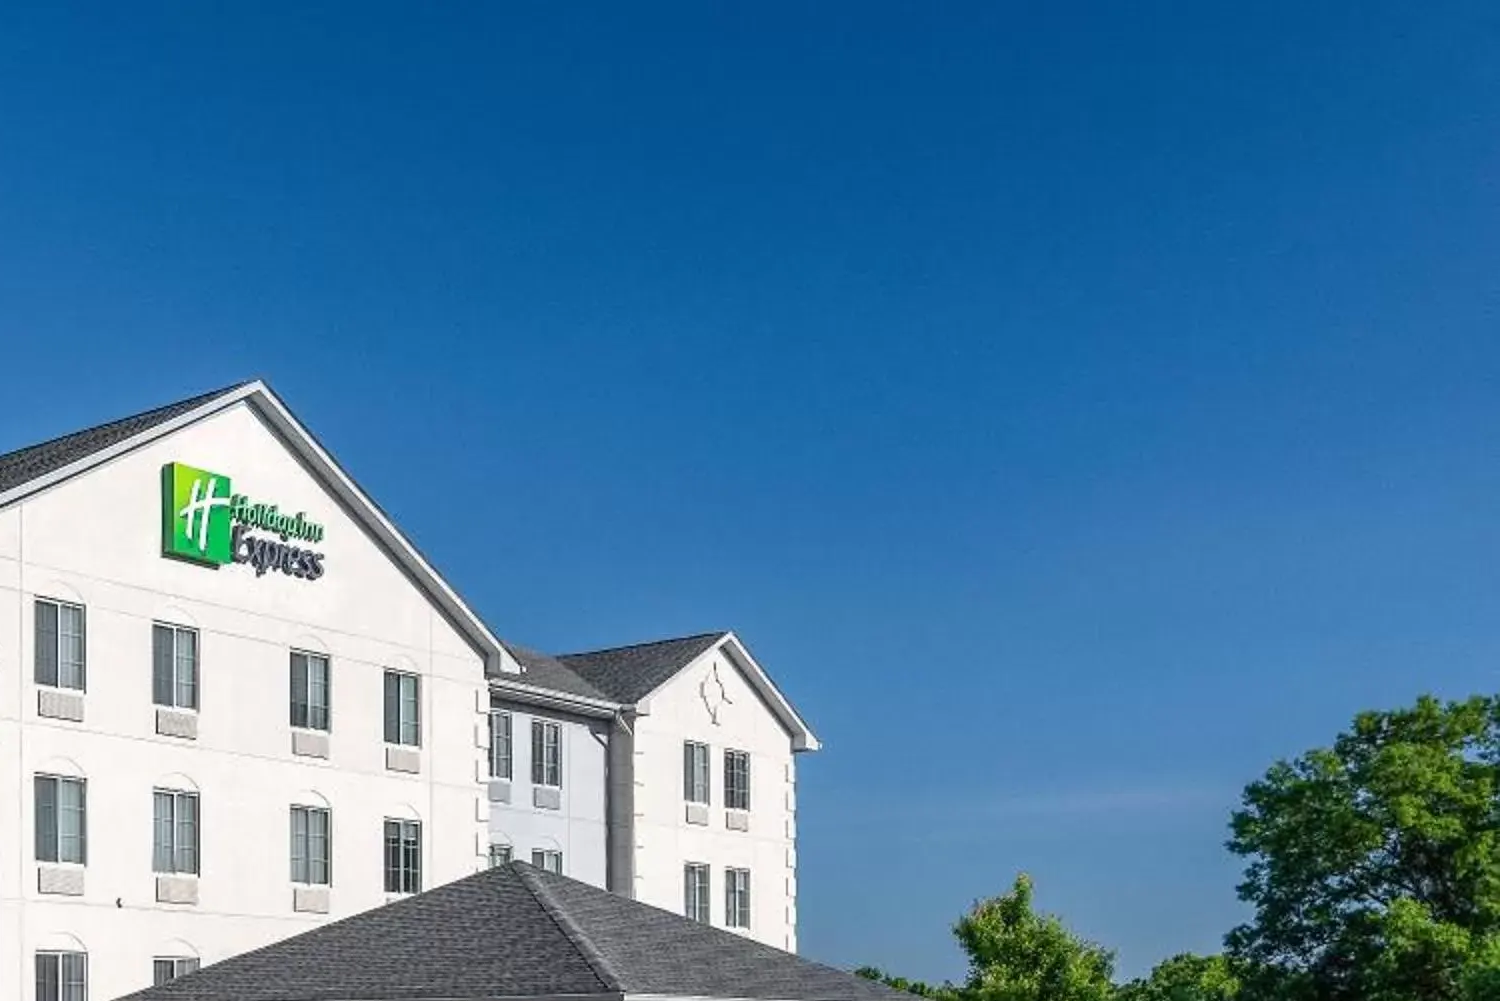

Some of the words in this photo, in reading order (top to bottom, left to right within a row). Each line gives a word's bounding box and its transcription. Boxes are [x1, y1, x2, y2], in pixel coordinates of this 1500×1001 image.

[230, 493, 298, 542] Holiday
[296, 511, 324, 544] Inn
[232, 525, 325, 580] Express
